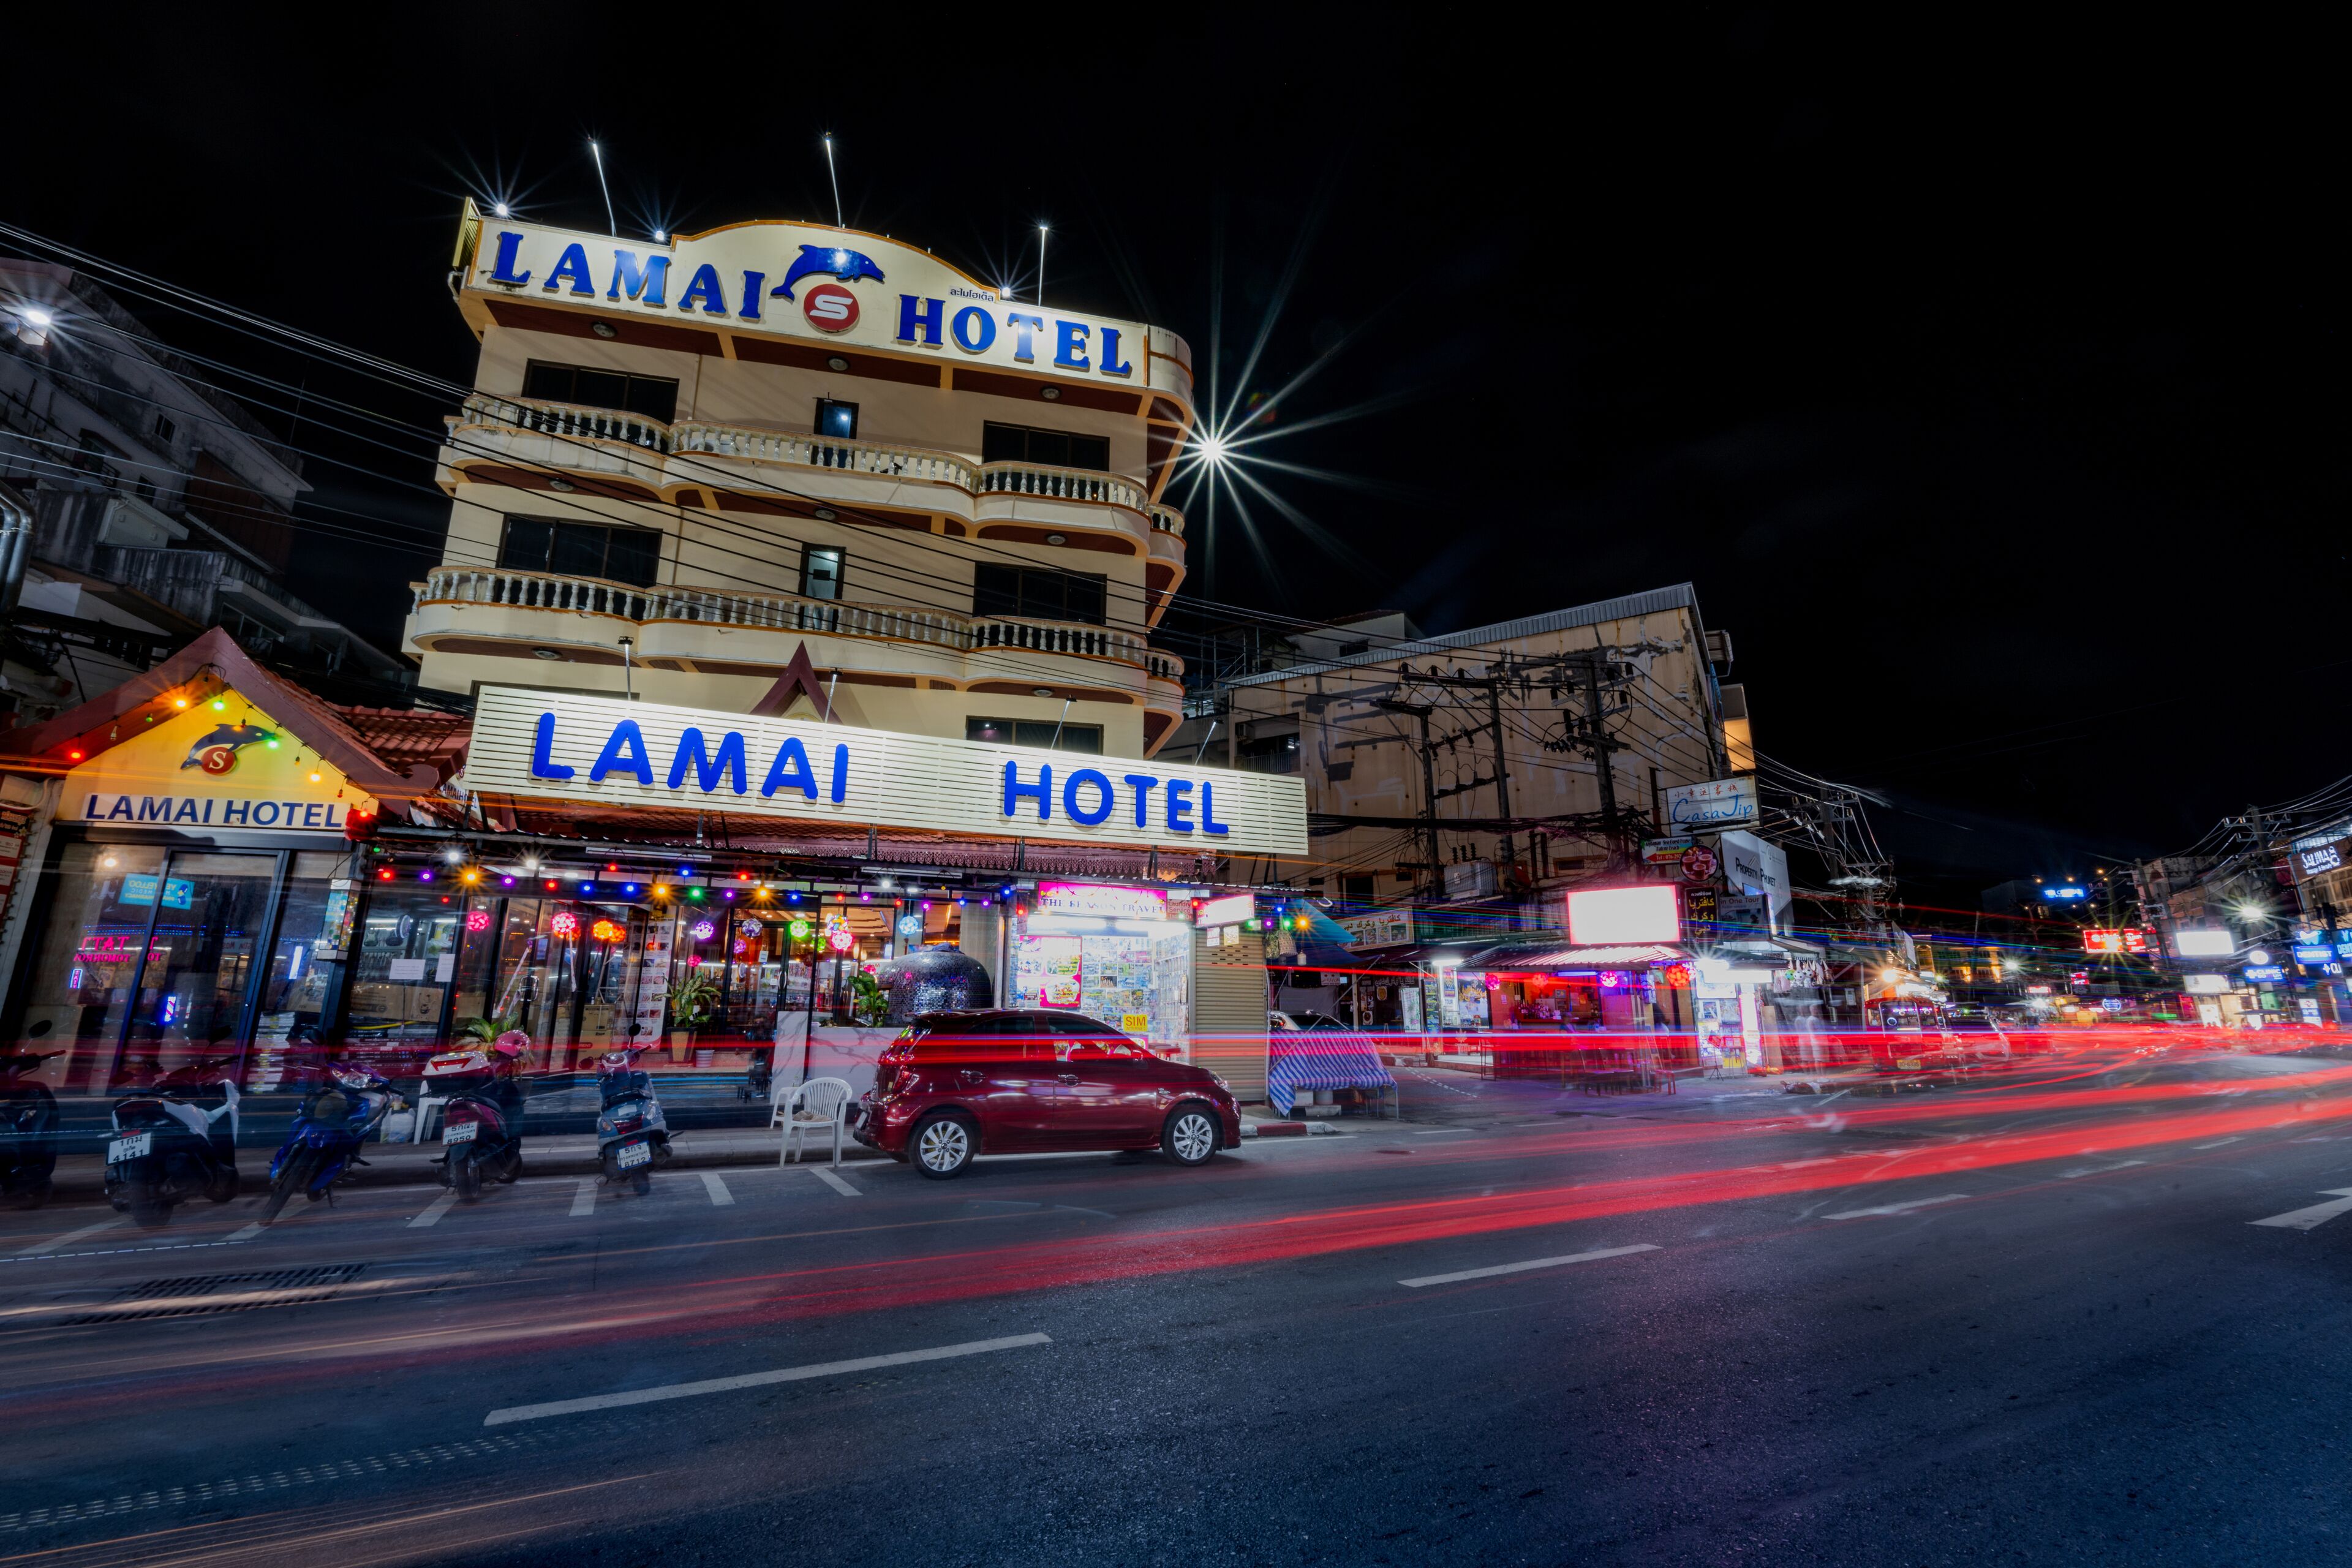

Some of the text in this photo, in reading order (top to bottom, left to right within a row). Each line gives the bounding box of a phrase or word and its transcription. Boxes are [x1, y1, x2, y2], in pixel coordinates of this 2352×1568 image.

[491, 231, 1131, 375] LAMAI HOTEL
[208, 750, 227, 769] S
[530, 711, 1230, 835] LAMAI HOTEL
[86, 795, 342, 827] LAMAI HOTEL
[1735, 856, 1757, 880] PROPERTY
[1760, 867, 1776, 888] PHUKET
[1041, 898, 1065, 907] THE
[1125, 1016, 1146, 1027] SIM
[447, 1135, 471, 1144] 8950
[113, 1149, 144, 1162] 4141
